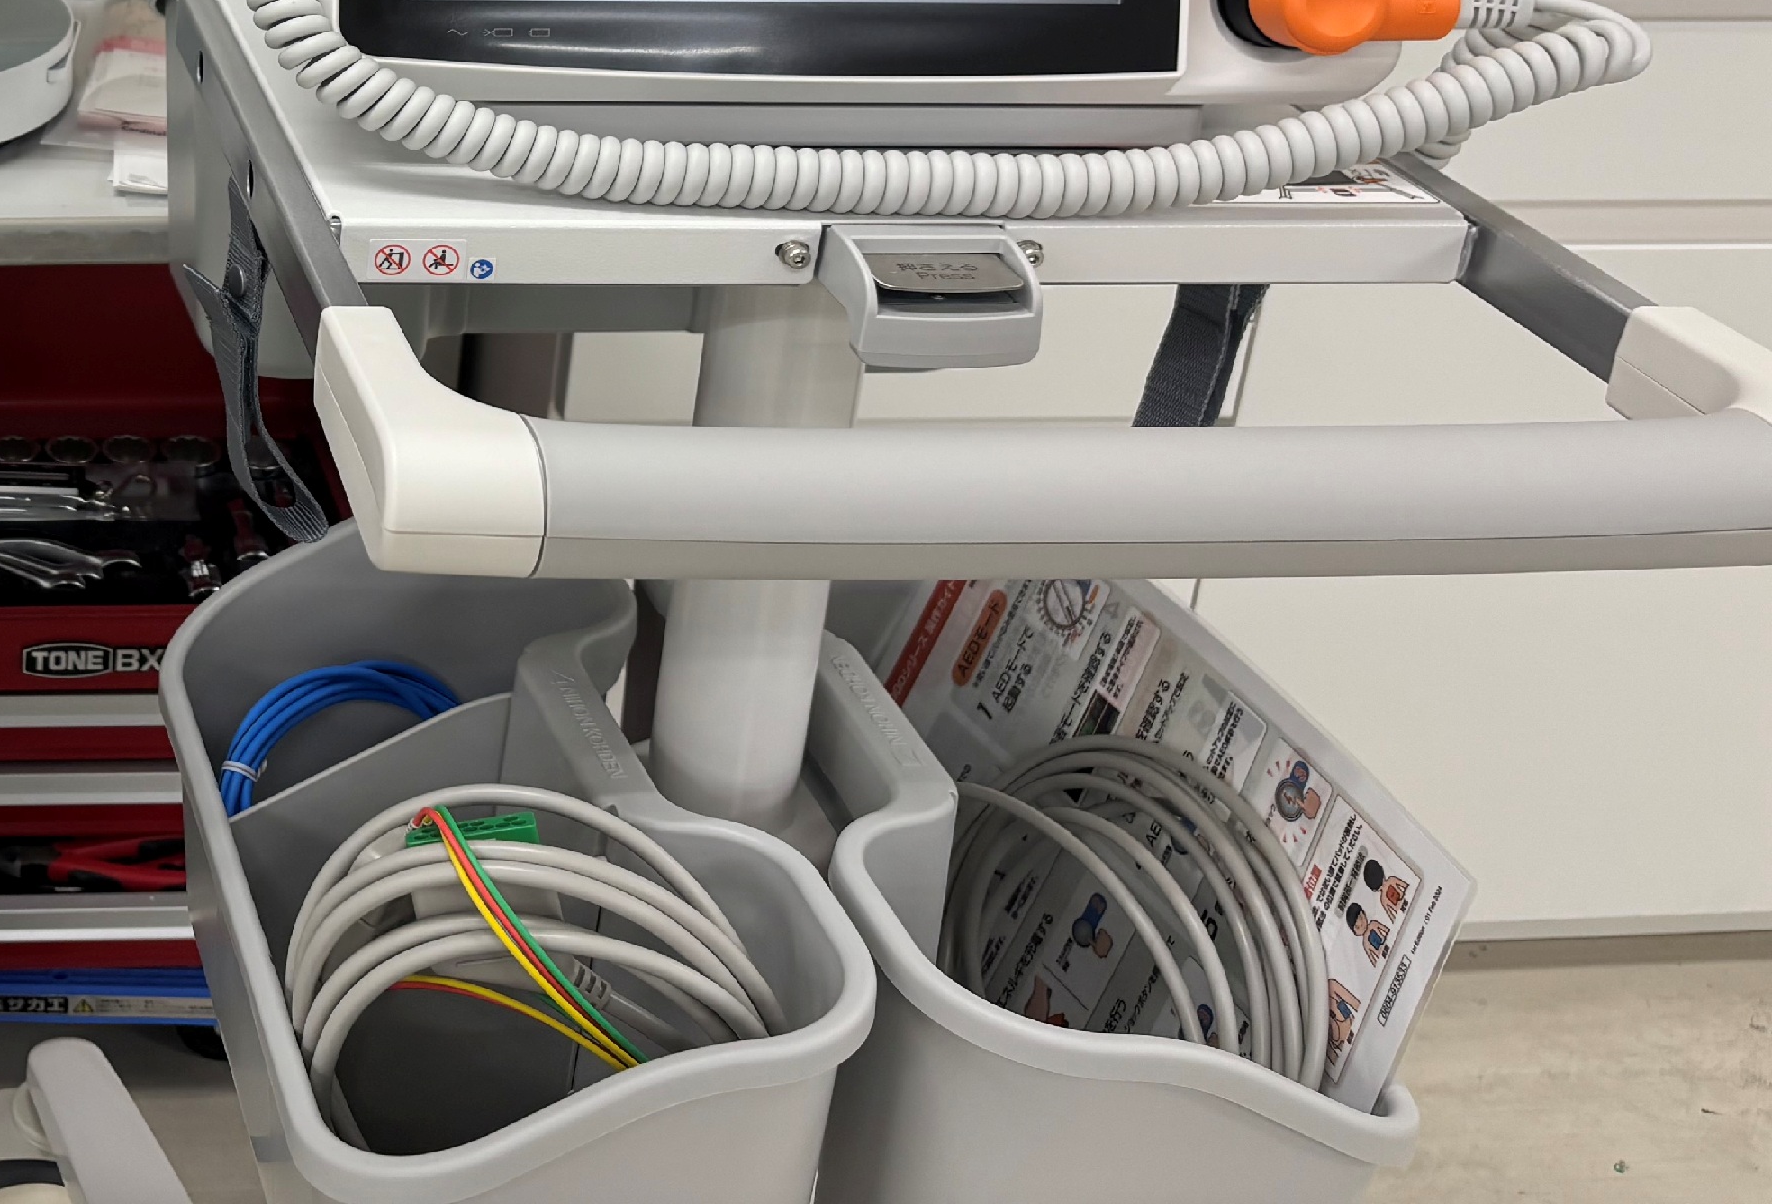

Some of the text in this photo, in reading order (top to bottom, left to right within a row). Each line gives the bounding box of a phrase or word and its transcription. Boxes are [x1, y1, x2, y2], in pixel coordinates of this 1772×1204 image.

[916, 271, 975, 280] Press
[956, 598, 1003, 678] AEDモード
[30, 649, 106, 673] TONE
[6, 997, 67, 1013] サカエ
